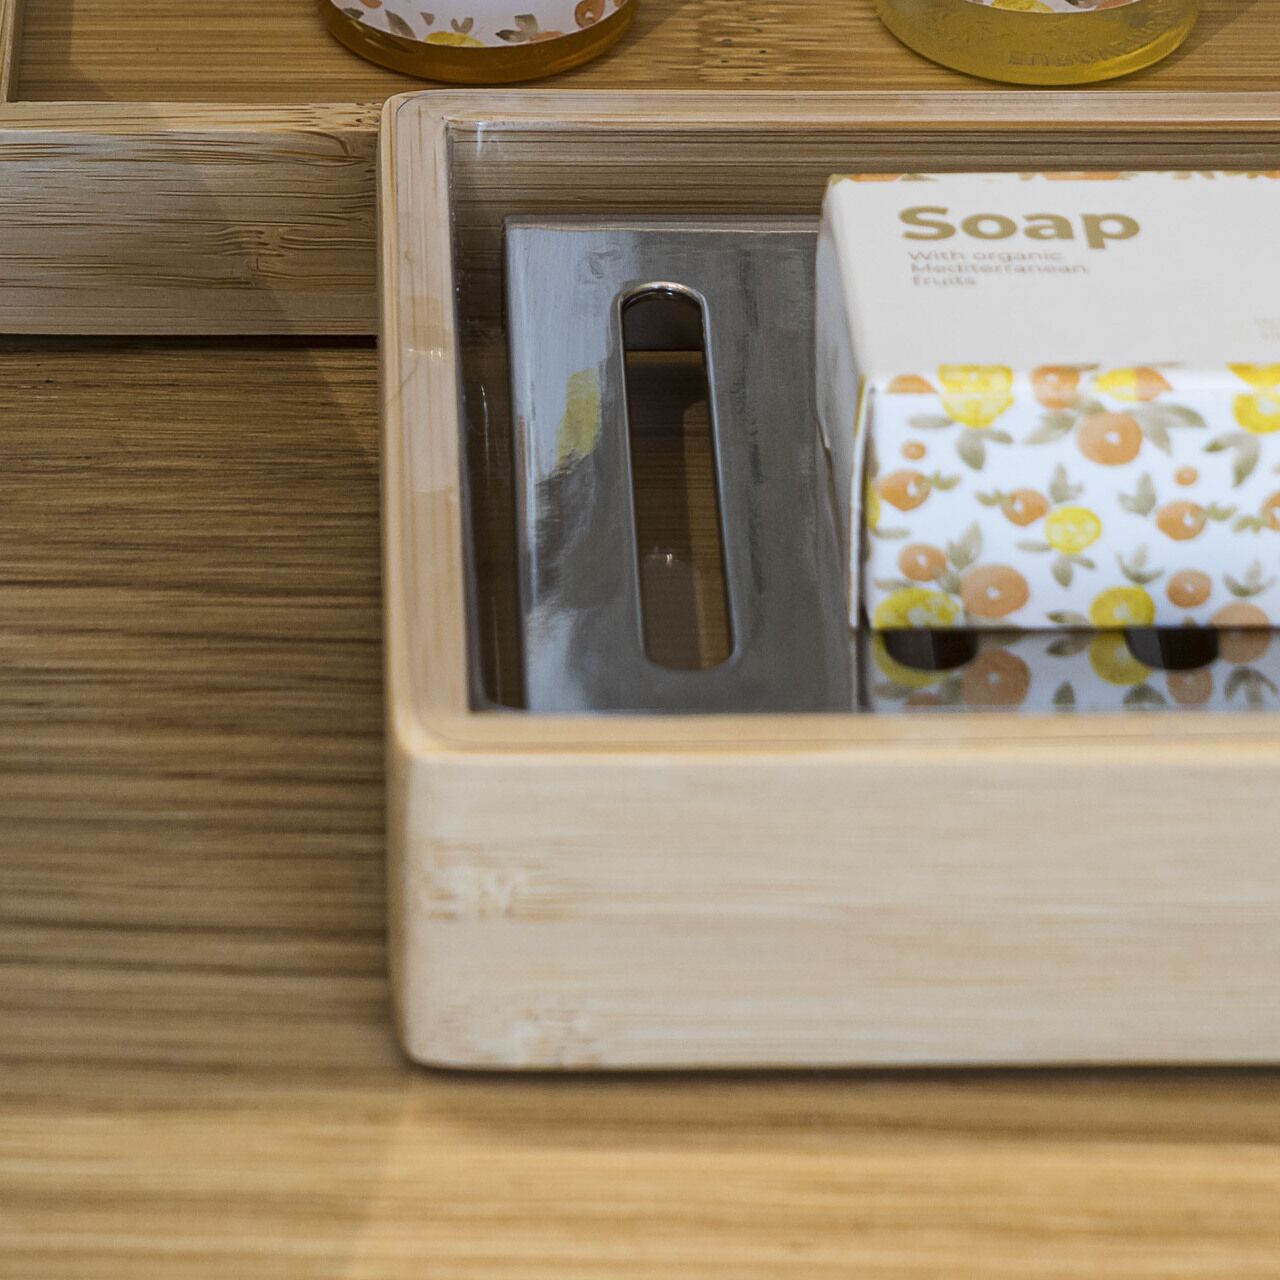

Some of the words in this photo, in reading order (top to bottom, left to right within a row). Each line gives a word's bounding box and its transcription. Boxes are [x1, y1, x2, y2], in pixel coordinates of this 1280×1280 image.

[899, 204, 1141, 249] Soap
[907, 249, 966, 262] With
[972, 249, 1065, 264] organic
